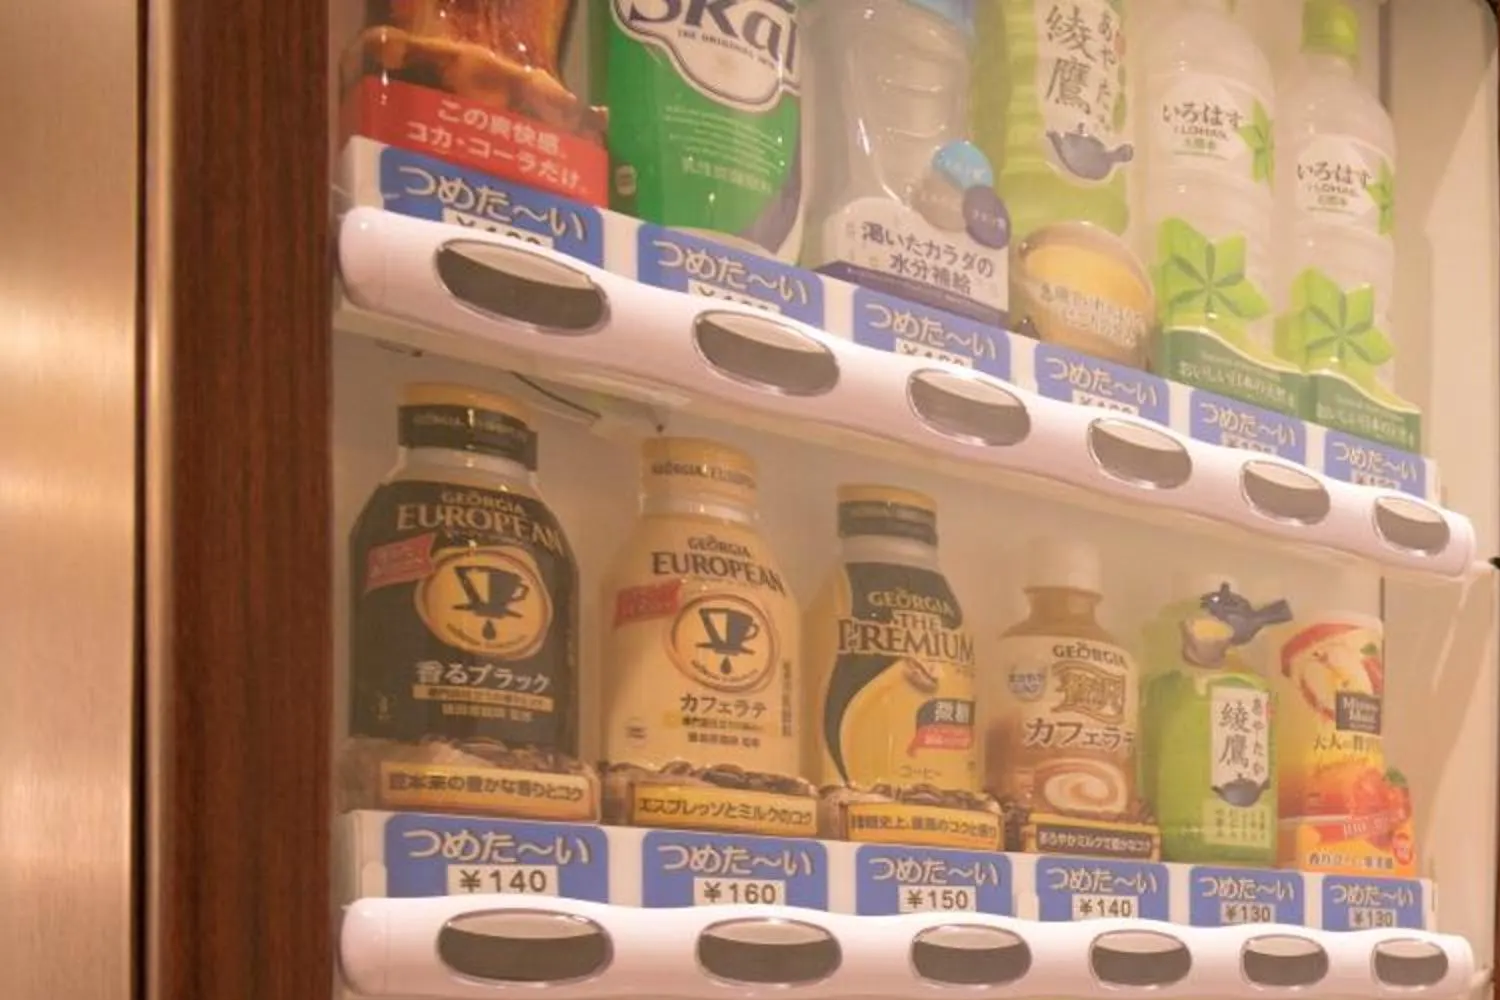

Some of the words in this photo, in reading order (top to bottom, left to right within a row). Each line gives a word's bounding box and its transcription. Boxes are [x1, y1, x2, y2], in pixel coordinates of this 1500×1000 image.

[1046, 4, 1097, 115] 綾鷹
[1162, 102, 1244, 128] いろはす
[1297, 161, 1372, 189] いろはす
[861, 221, 994, 279] 渇いたカラダの
[890, 253, 973, 296] 水分補給
[396, 503, 564, 556] EUROPEAN
[651, 551, 787, 598] EUROPEAN
[837, 617, 976, 667] PREMIUM
[415, 660, 551, 694] 香るブラック
[680, 692, 768, 720] カフェラテ
[1218, 700, 1252, 769] 綾鷹
[639, 796, 814, 825] エスプレッソとミルクのコク
[459, 868, 548, 893] ¥140
[702, 881, 778, 905] ¥160
[907, 889, 970, 910] ¥150
[1079, 898, 1133, 918] ¥140
[1224, 904, 1272, 924] ¥130
